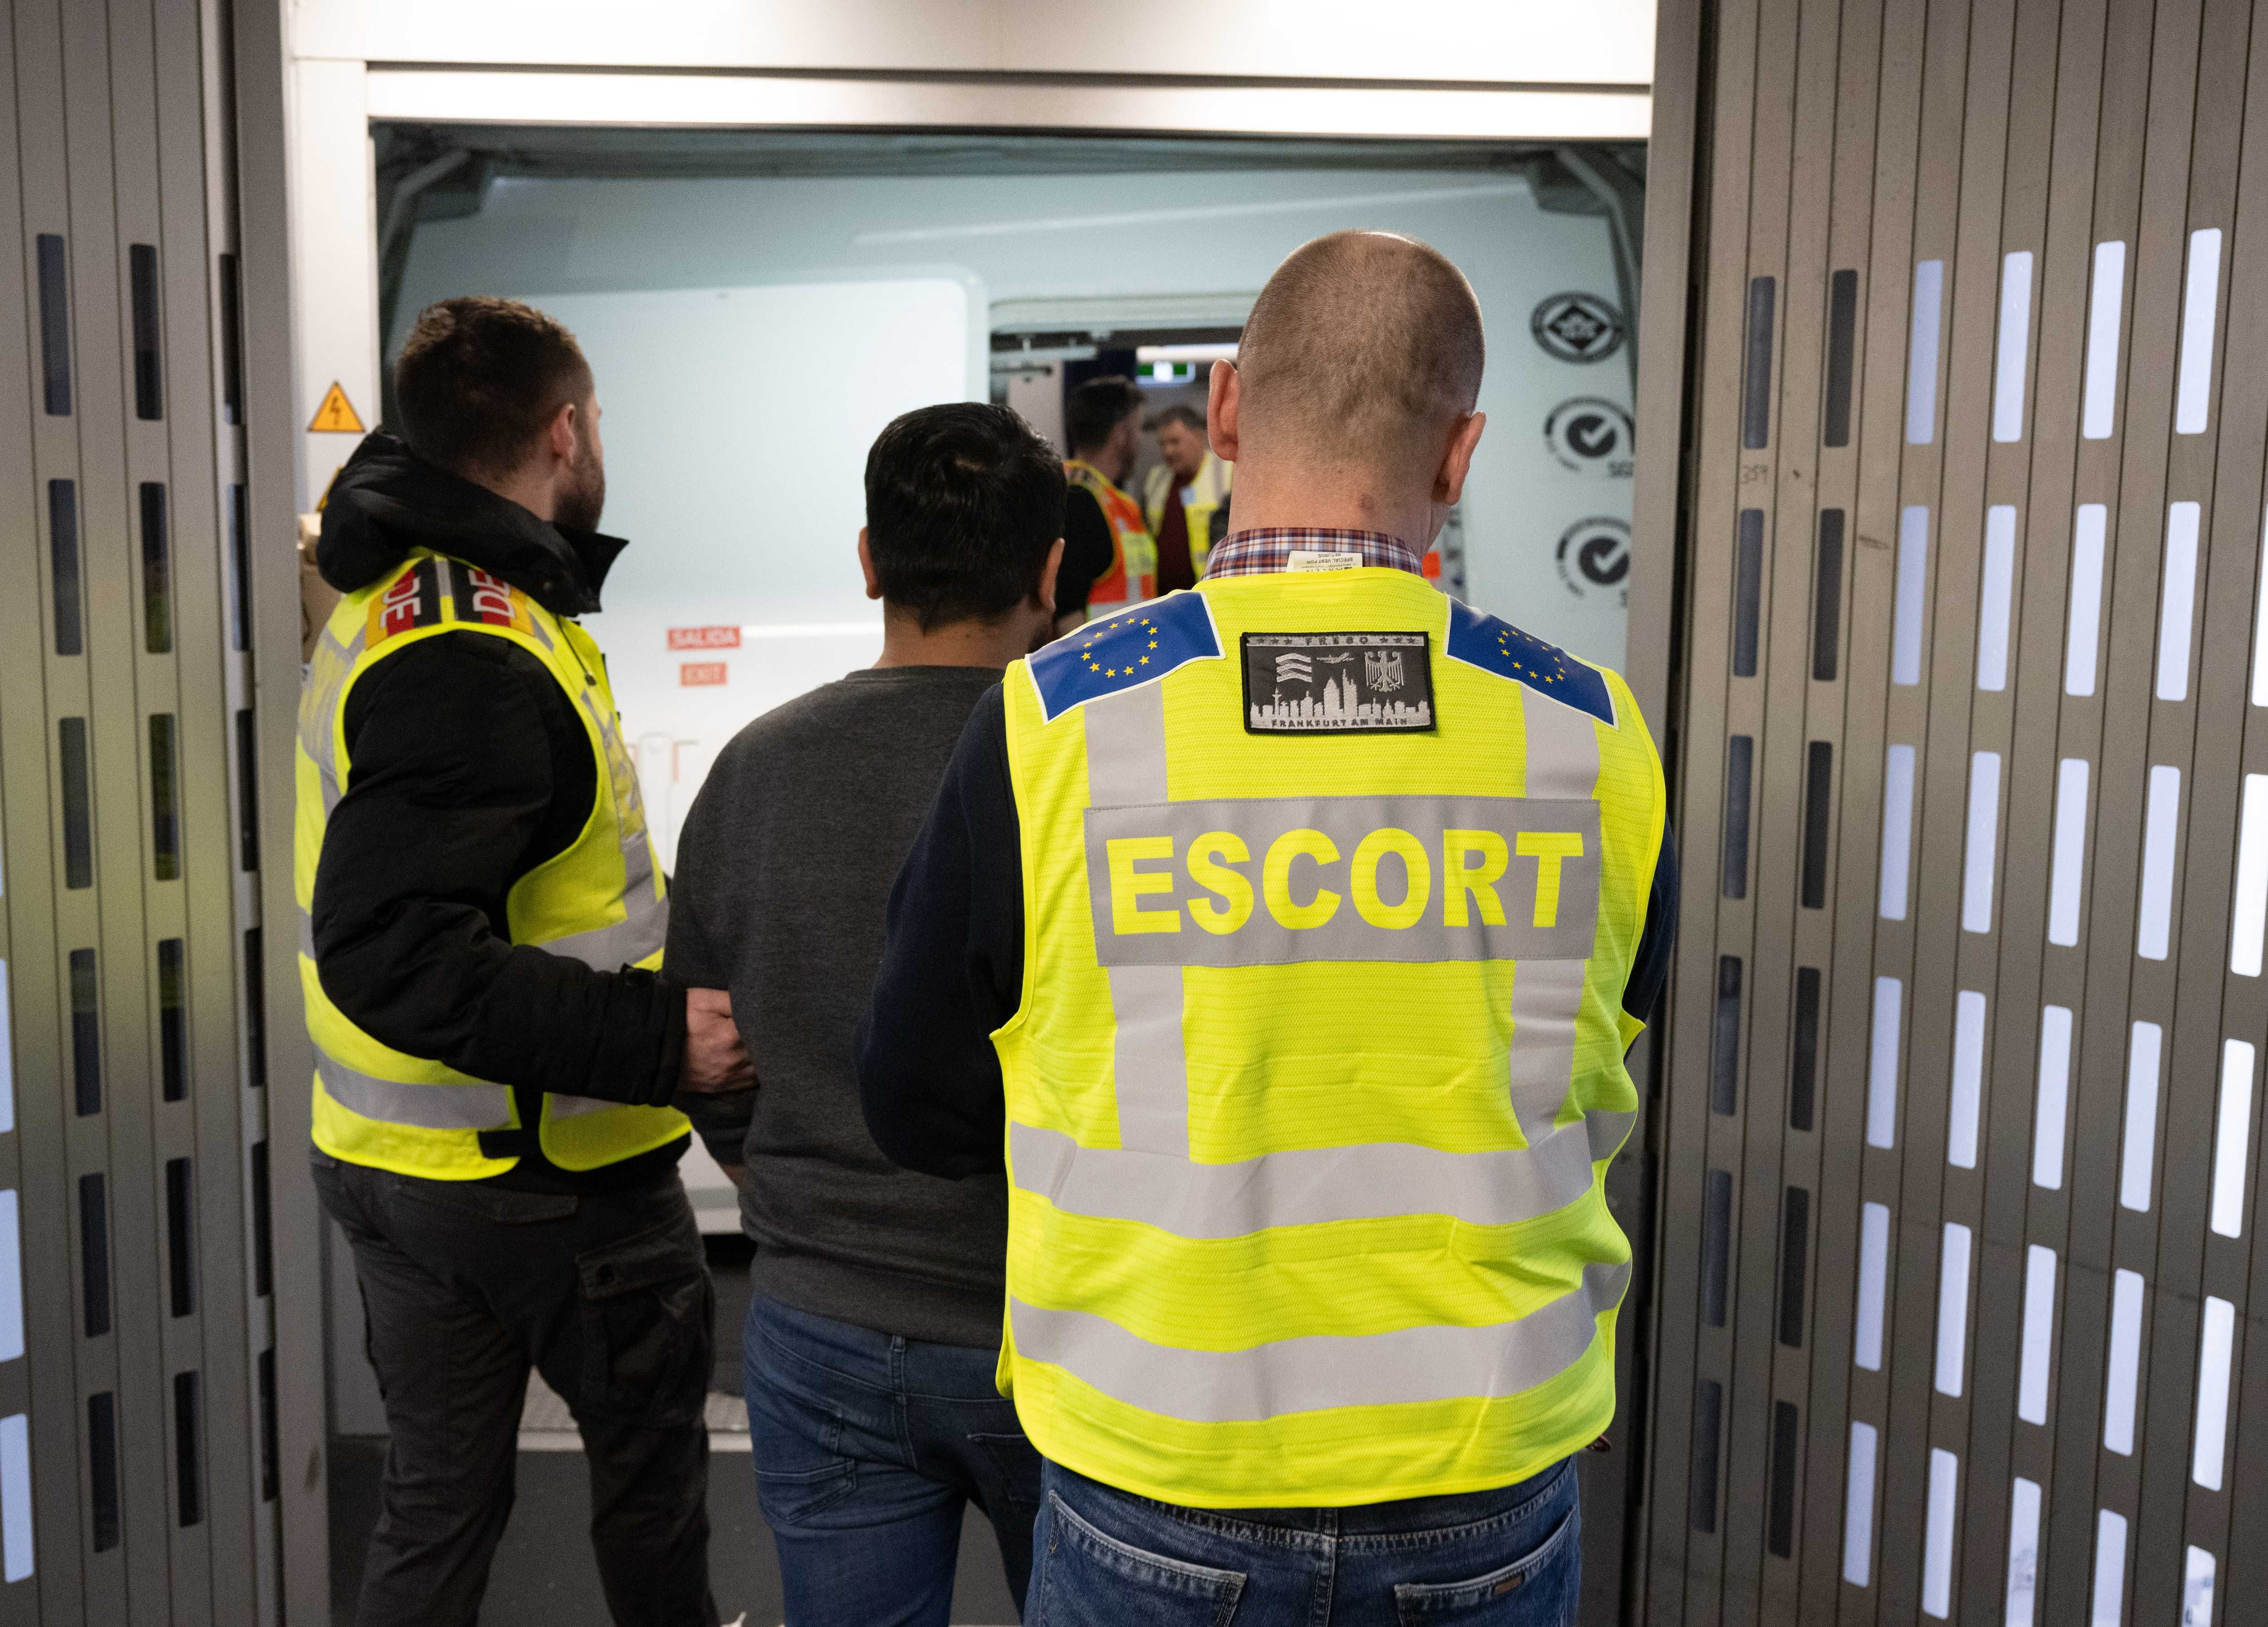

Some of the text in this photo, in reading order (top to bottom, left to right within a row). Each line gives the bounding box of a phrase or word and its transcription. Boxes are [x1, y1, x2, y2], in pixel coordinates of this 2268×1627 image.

[671, 629, 736, 647] SALIDA
[684, 666, 721, 682] EXIT
[1271, 719, 1347, 728] FRANKFURT
[1105, 828, 1584, 936] ESCORT
